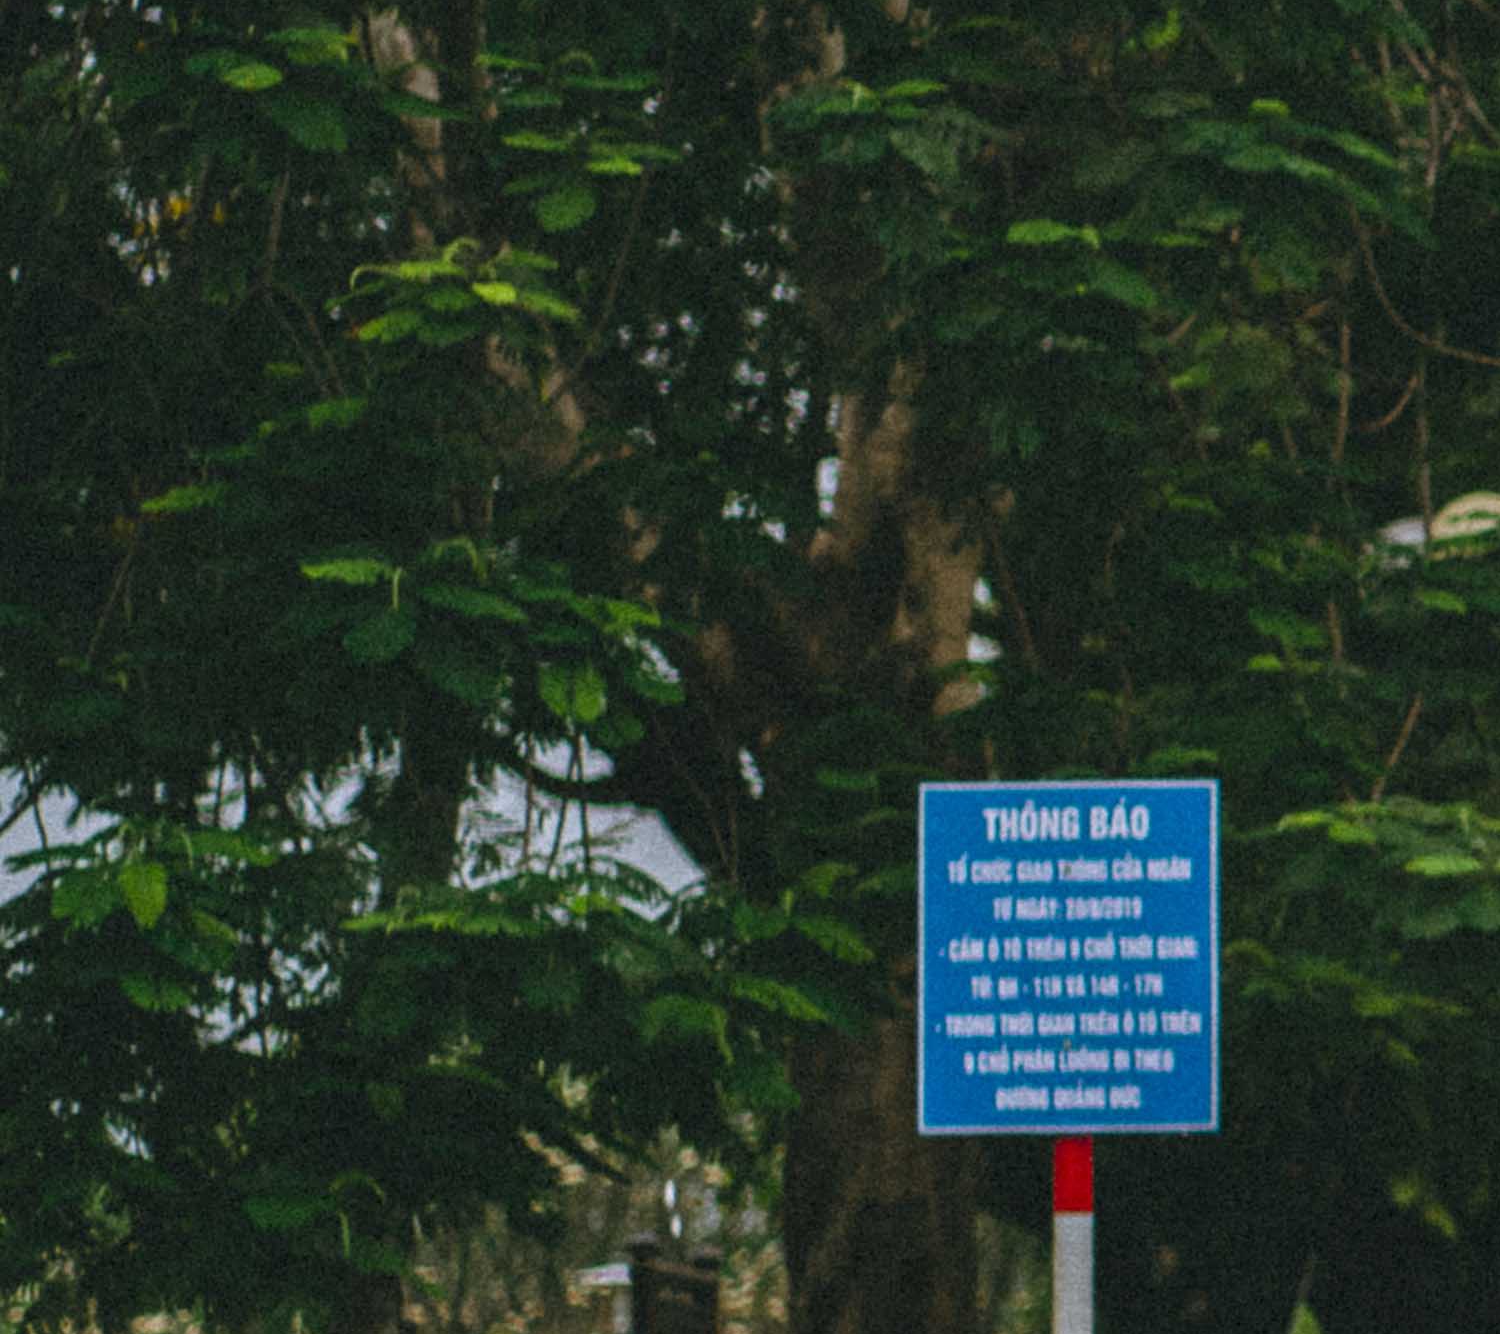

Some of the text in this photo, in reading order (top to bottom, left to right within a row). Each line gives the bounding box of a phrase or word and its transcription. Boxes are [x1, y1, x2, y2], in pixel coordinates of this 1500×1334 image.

[984, 799, 1149, 840] THÔNG BÁO
[1017, 862, 1052, 881] GIAO
[1038, 1015, 1074, 1035] GIAN
